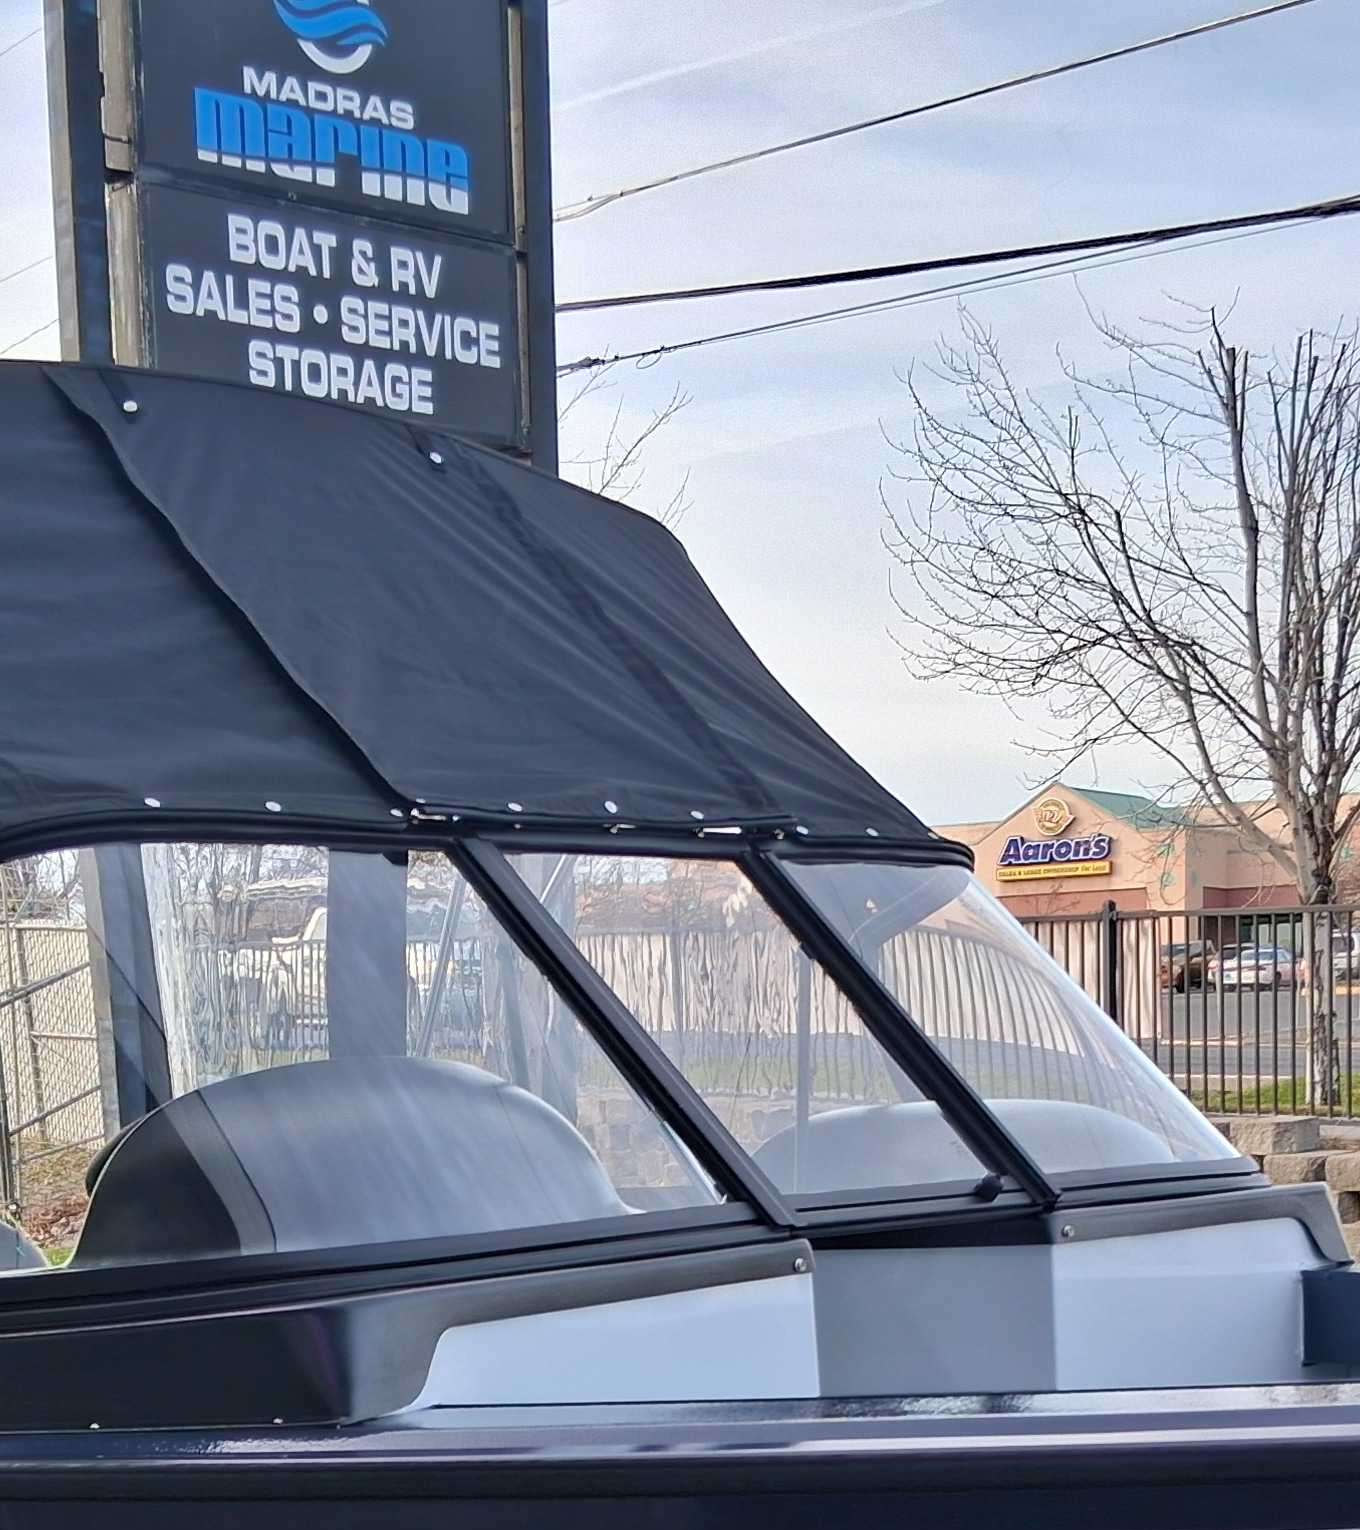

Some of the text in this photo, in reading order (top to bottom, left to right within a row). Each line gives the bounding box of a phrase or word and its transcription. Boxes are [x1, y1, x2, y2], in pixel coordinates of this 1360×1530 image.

[242, 65, 416, 131] MADRAS
[194, 86, 470, 216] marine
[227, 212, 442, 300] BOAT & RV
[165, 263, 502, 370] SALES SERVICE
[247, 339, 435, 416] STORAGE
[998, 833, 1112, 866] Aaron's
